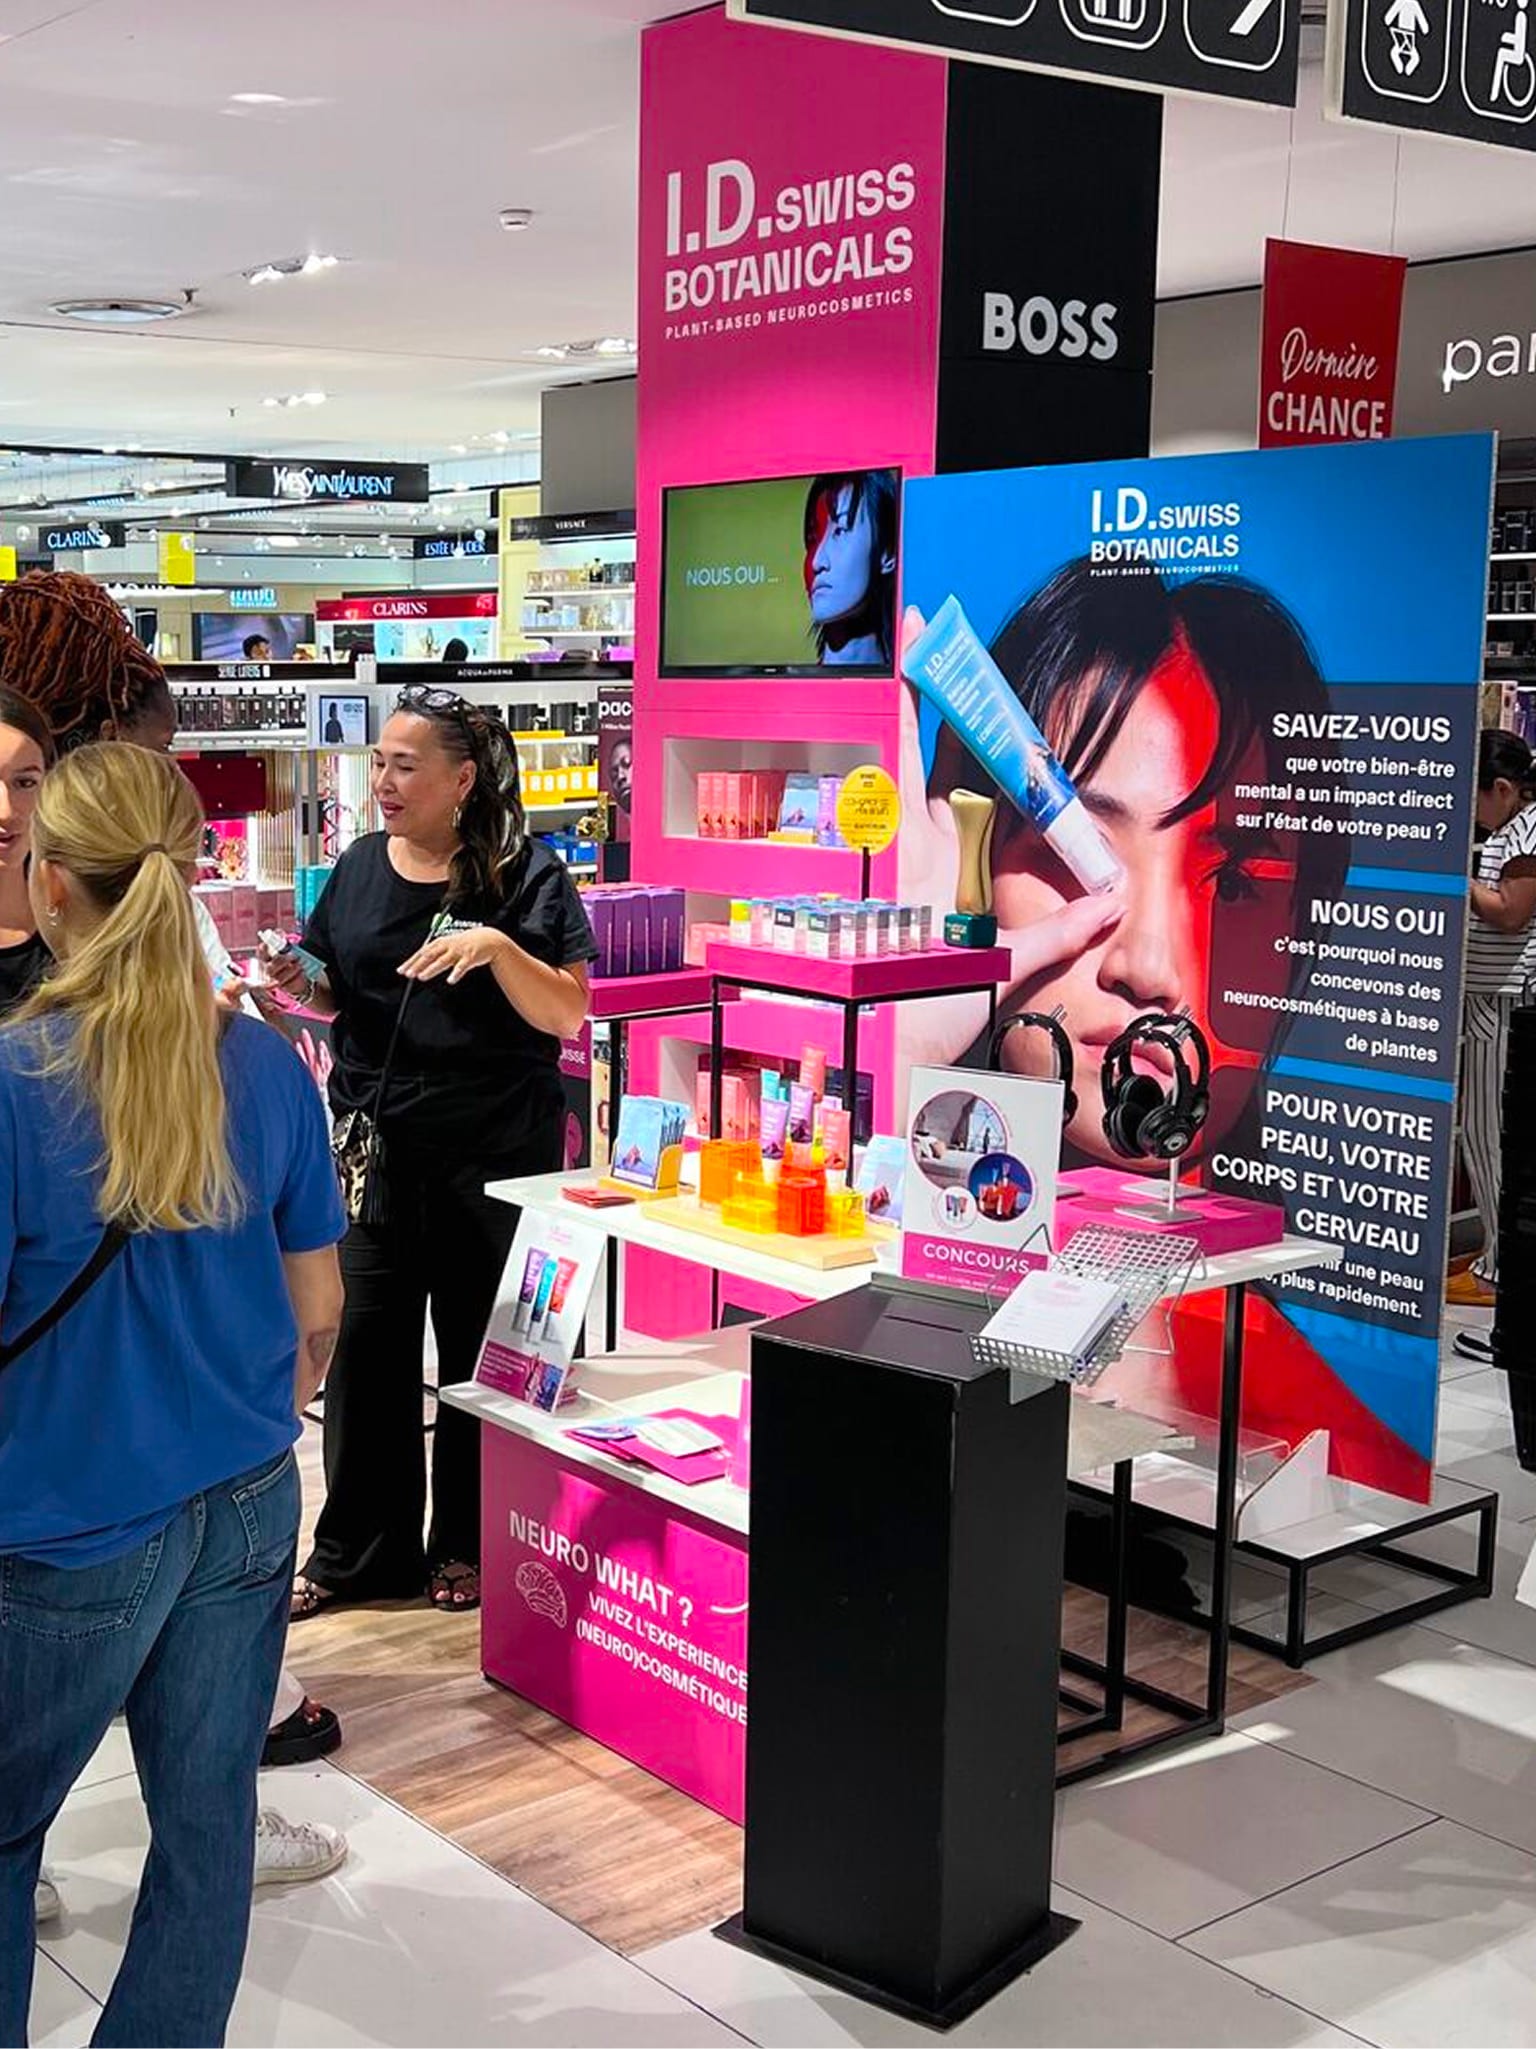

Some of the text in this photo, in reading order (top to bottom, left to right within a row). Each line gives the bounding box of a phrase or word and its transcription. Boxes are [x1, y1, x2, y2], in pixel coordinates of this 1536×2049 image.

[664, 227, 914, 312] BOTANICALS
[665, 287, 913, 340] PLANT-BASED NEUROCOSMETICS
[983, 292, 1118, 361] BOSS
[1281, 327, 1380, 382] Dernière
[1268, 391, 1385, 439] CHANCE
[1090, 534, 1240, 563] BOTANICALS
[686, 566, 732, 587] NOUS
[734, 565, 765, 585] OUI
[372, 601, 428, 617] CLARINS
[1273, 713, 1450, 742] SAVEZ-VOUS
[1286, 757, 1455, 778] que votre bien-être
[1235, 784, 1454, 810] mental a un impact direct
[1235, 812, 1448, 841] sur l'état de votre peau ?
[1311, 900, 1445, 936] NOUS OUI
[1274, 936, 1444, 971] c'est pourquoi nous
[1311, 972, 1442, 1001] concevons des
[1223, 989, 1440, 1032] neurocosmétiques à base
[1345, 1034, 1438, 1063] de plantes
[1266, 1090, 1433, 1142] POUR VOTRE
[1261, 1127, 1432, 1180] PEAU, VOTRE
[1211, 1153, 1428, 1220] CORPS ET VOTRE
[1295, 1208, 1420, 1256] CERVEAU
[923, 1243, 1030, 1274] CONCOURS
[1345, 1263, 1377, 1280] une
[1380, 1269, 1424, 1292] peau
[1281, 1271, 1422, 1318] plus rapidement.
[509, 1510, 693, 1627] NEURO WHAT ?
[589, 1591, 633, 1631] VIVEZ
[576, 1618, 748, 1725] (NEURO)COSMÉTIQUE
